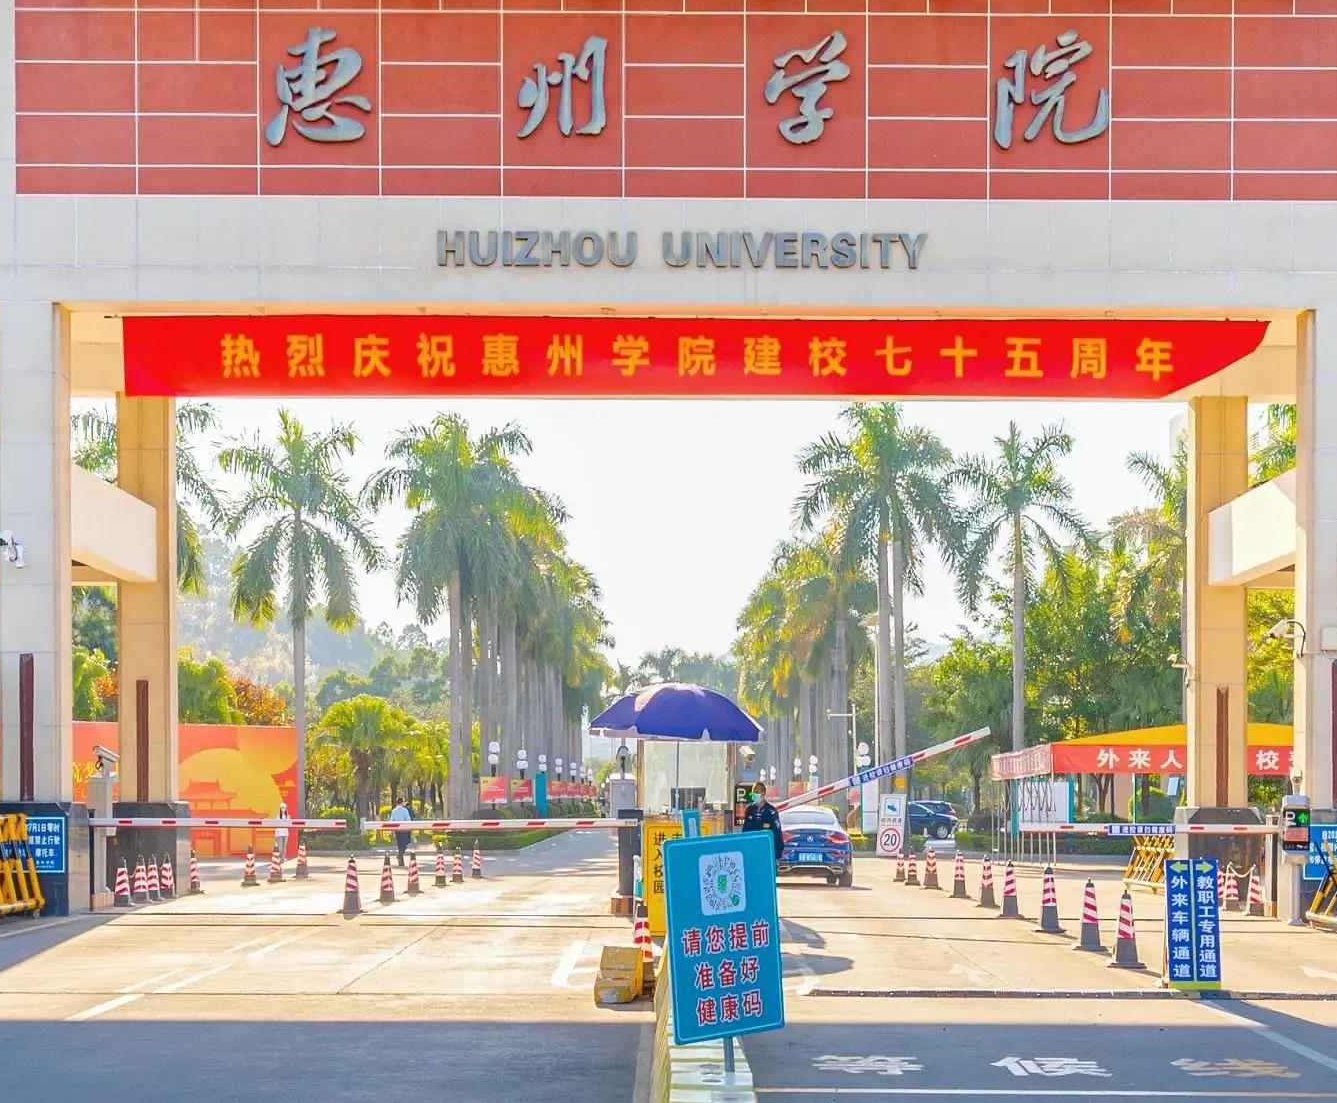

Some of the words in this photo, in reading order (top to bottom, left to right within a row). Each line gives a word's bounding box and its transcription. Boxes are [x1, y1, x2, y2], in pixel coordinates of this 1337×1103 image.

[264, 26, 1112, 148] 惠州学院
[436, 229, 638, 267] HUIZHOU
[663, 231, 929, 270] UNIVERSITY
[220, 331, 1177, 381] 热烈庆祝惠州学院建校七十五周年
[1256, 749, 1294, 771] 校
[883, 833, 897, 847] 20
[681, 919, 770, 957] 请您提前
[1171, 875, 1191, 978] 外来车辆通道
[1197, 875, 1217, 978] 教职工专用通道
[695, 956, 760, 990] 准备好
[696, 989, 763, 1026] 健康码
